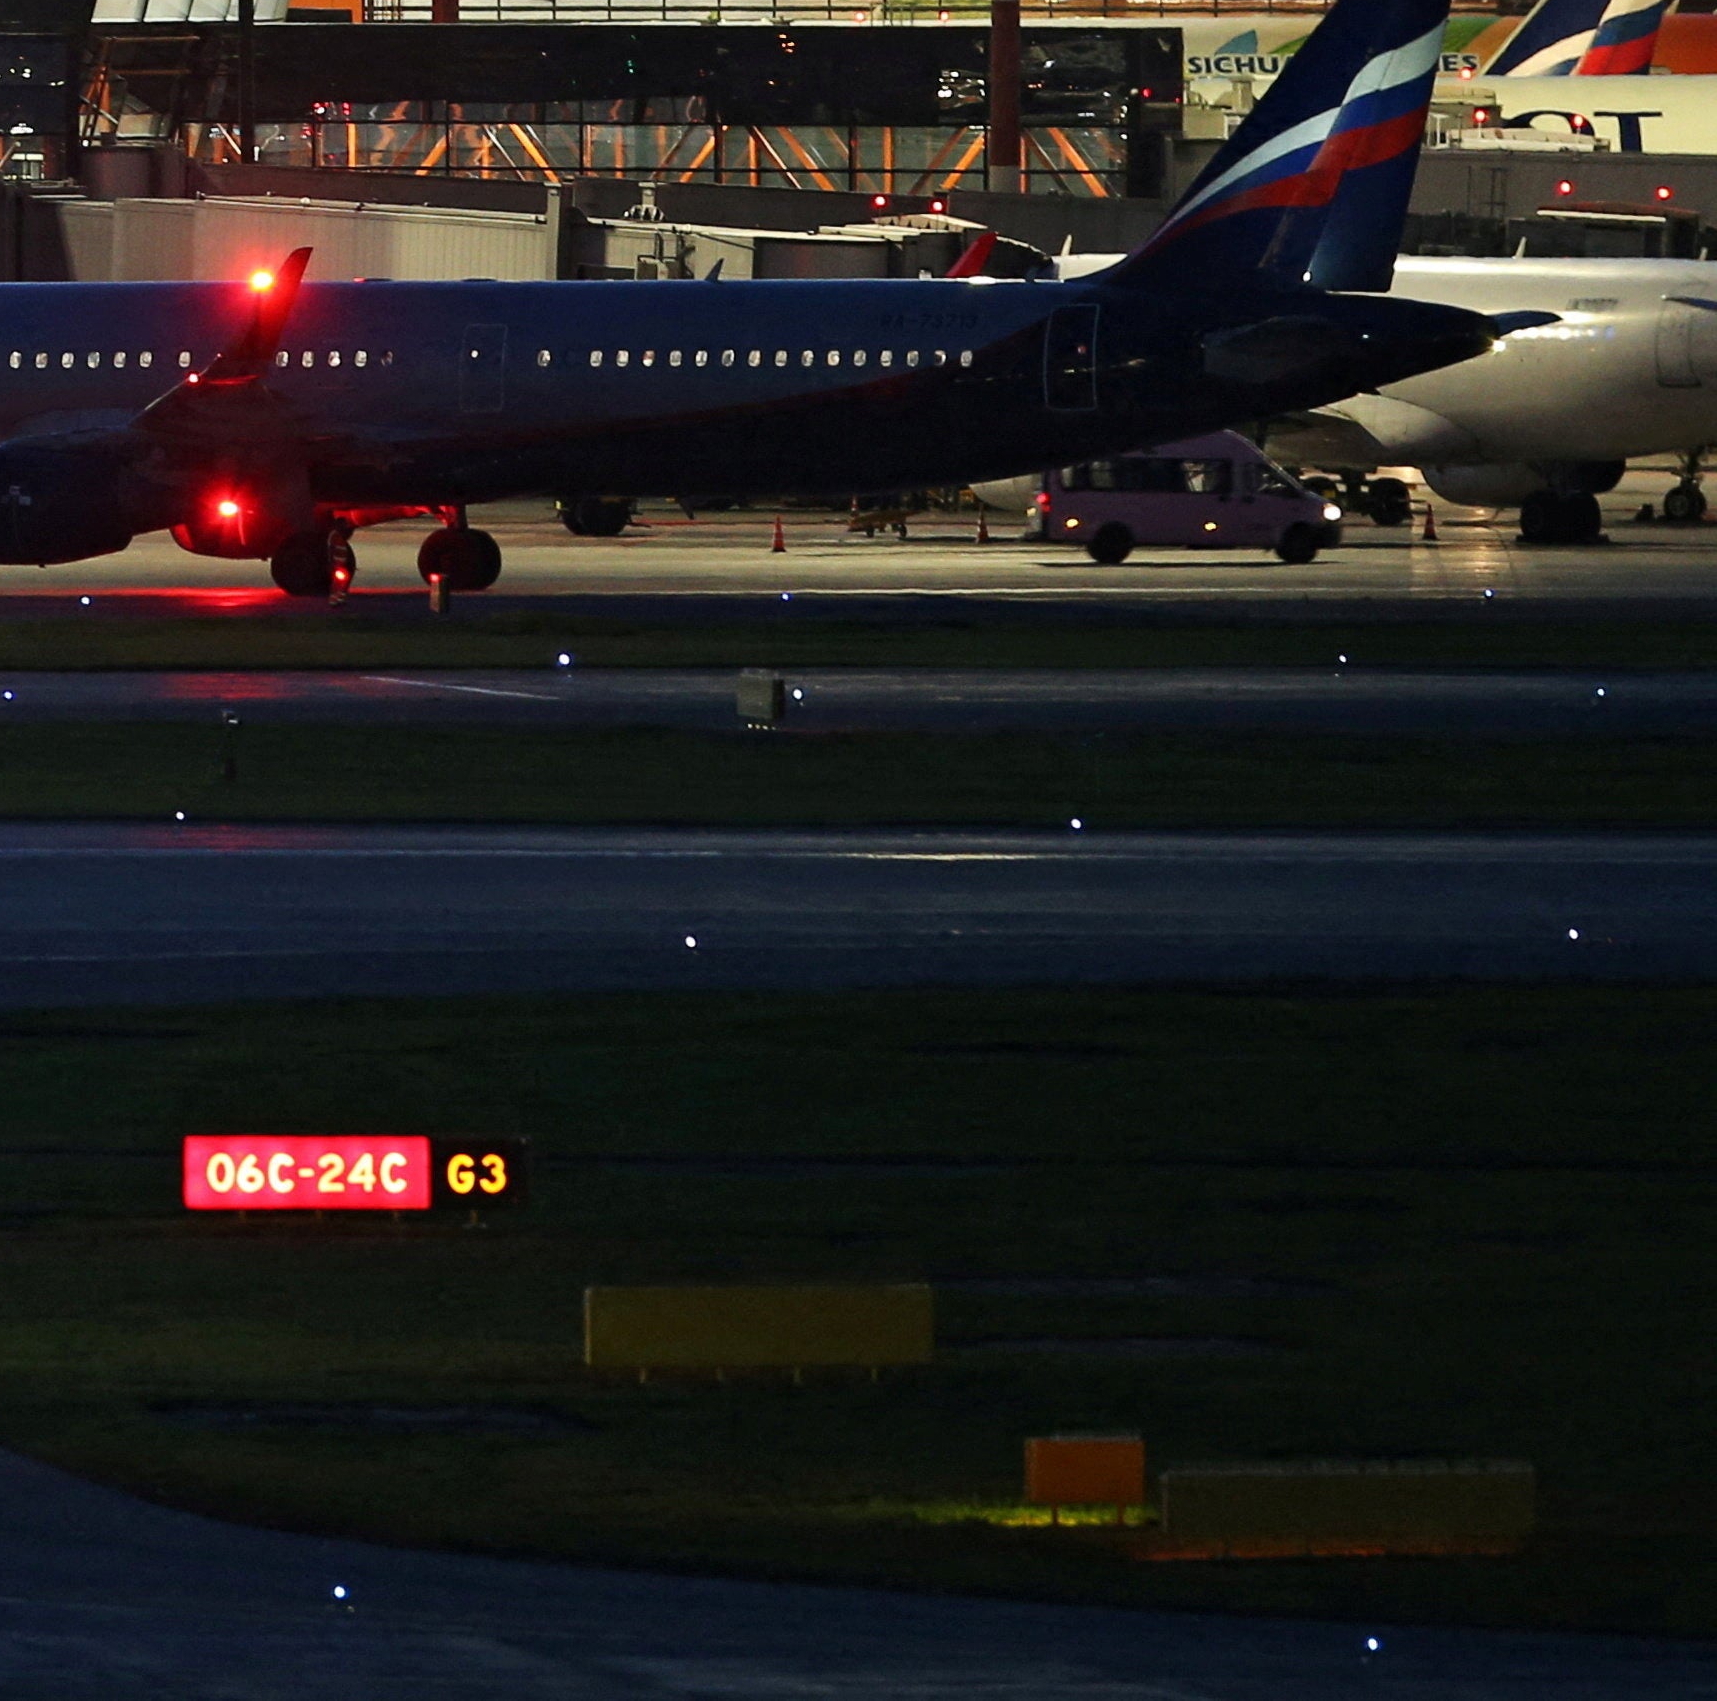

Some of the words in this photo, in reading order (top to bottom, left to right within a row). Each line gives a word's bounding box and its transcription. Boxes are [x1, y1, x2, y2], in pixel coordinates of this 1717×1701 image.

[1187, 55, 1292, 75] SICHU
[205, 1151, 409, 1195] 06C-24C
[445, 1152, 508, 1196] G3
